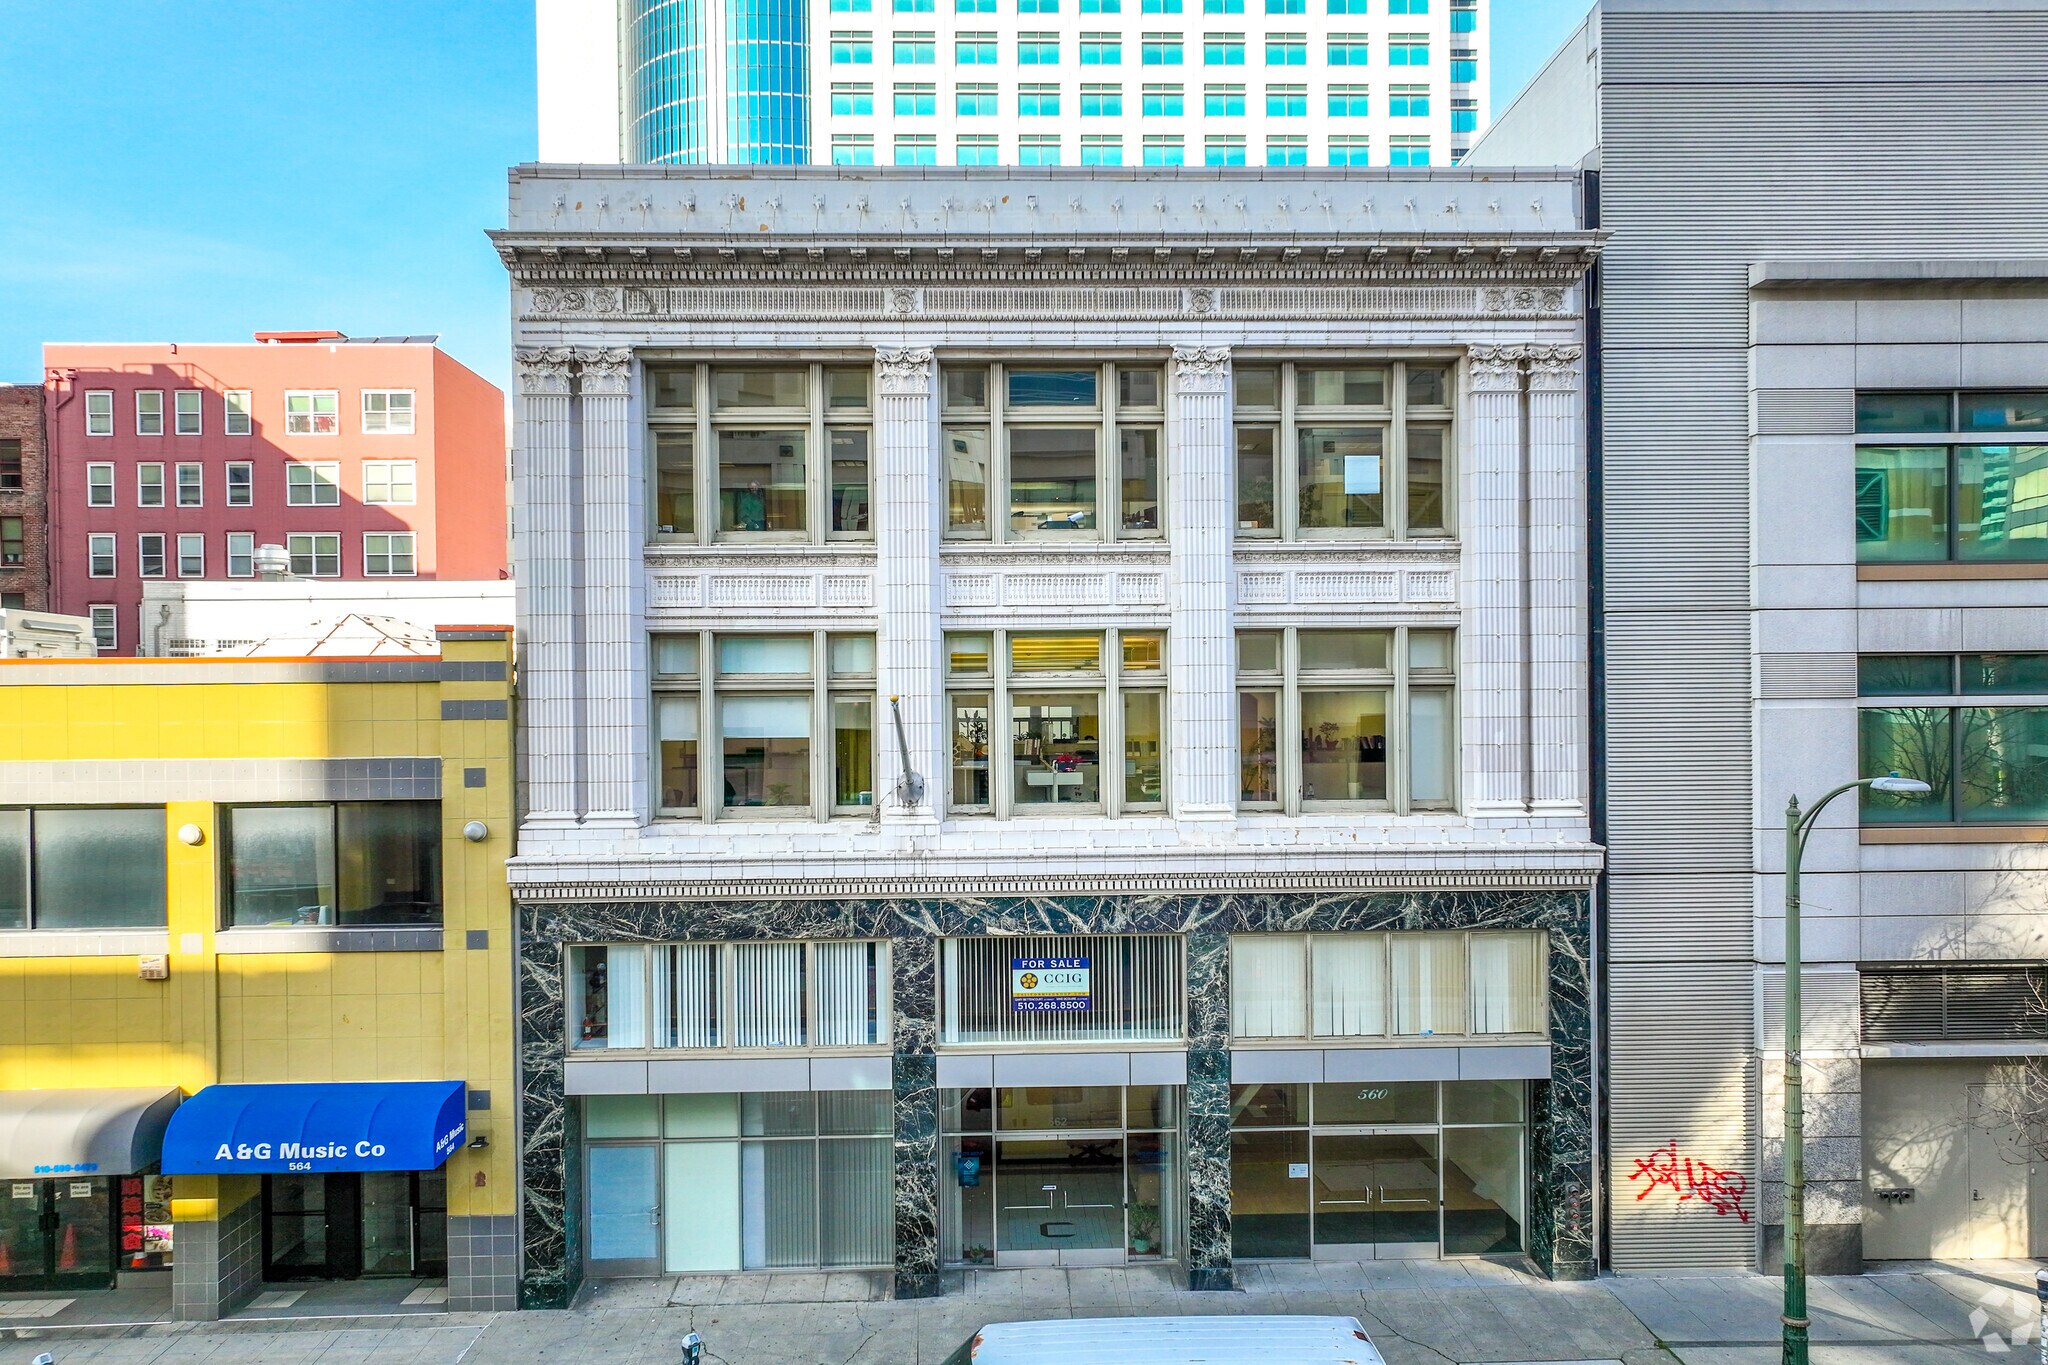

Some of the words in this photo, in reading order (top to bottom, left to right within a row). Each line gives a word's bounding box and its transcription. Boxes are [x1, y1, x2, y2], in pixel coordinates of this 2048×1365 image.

[1022, 960, 1045, 969] FOR
[1050, 959, 1081, 968] SALE
[1043, 973, 1083, 984] CCIG
[1017, 1001, 1086, 1010] 510.268.8500
[1357, 1088, 1389, 1100] 560
[449, 1122, 465, 1141] Music
[214, 1142, 272, 1160] A&G
[279, 1141, 348, 1159] Music
[354, 1140, 386, 1158] Co
[446, 1142, 456, 1155] 564
[288, 1161, 312, 1171] 564
